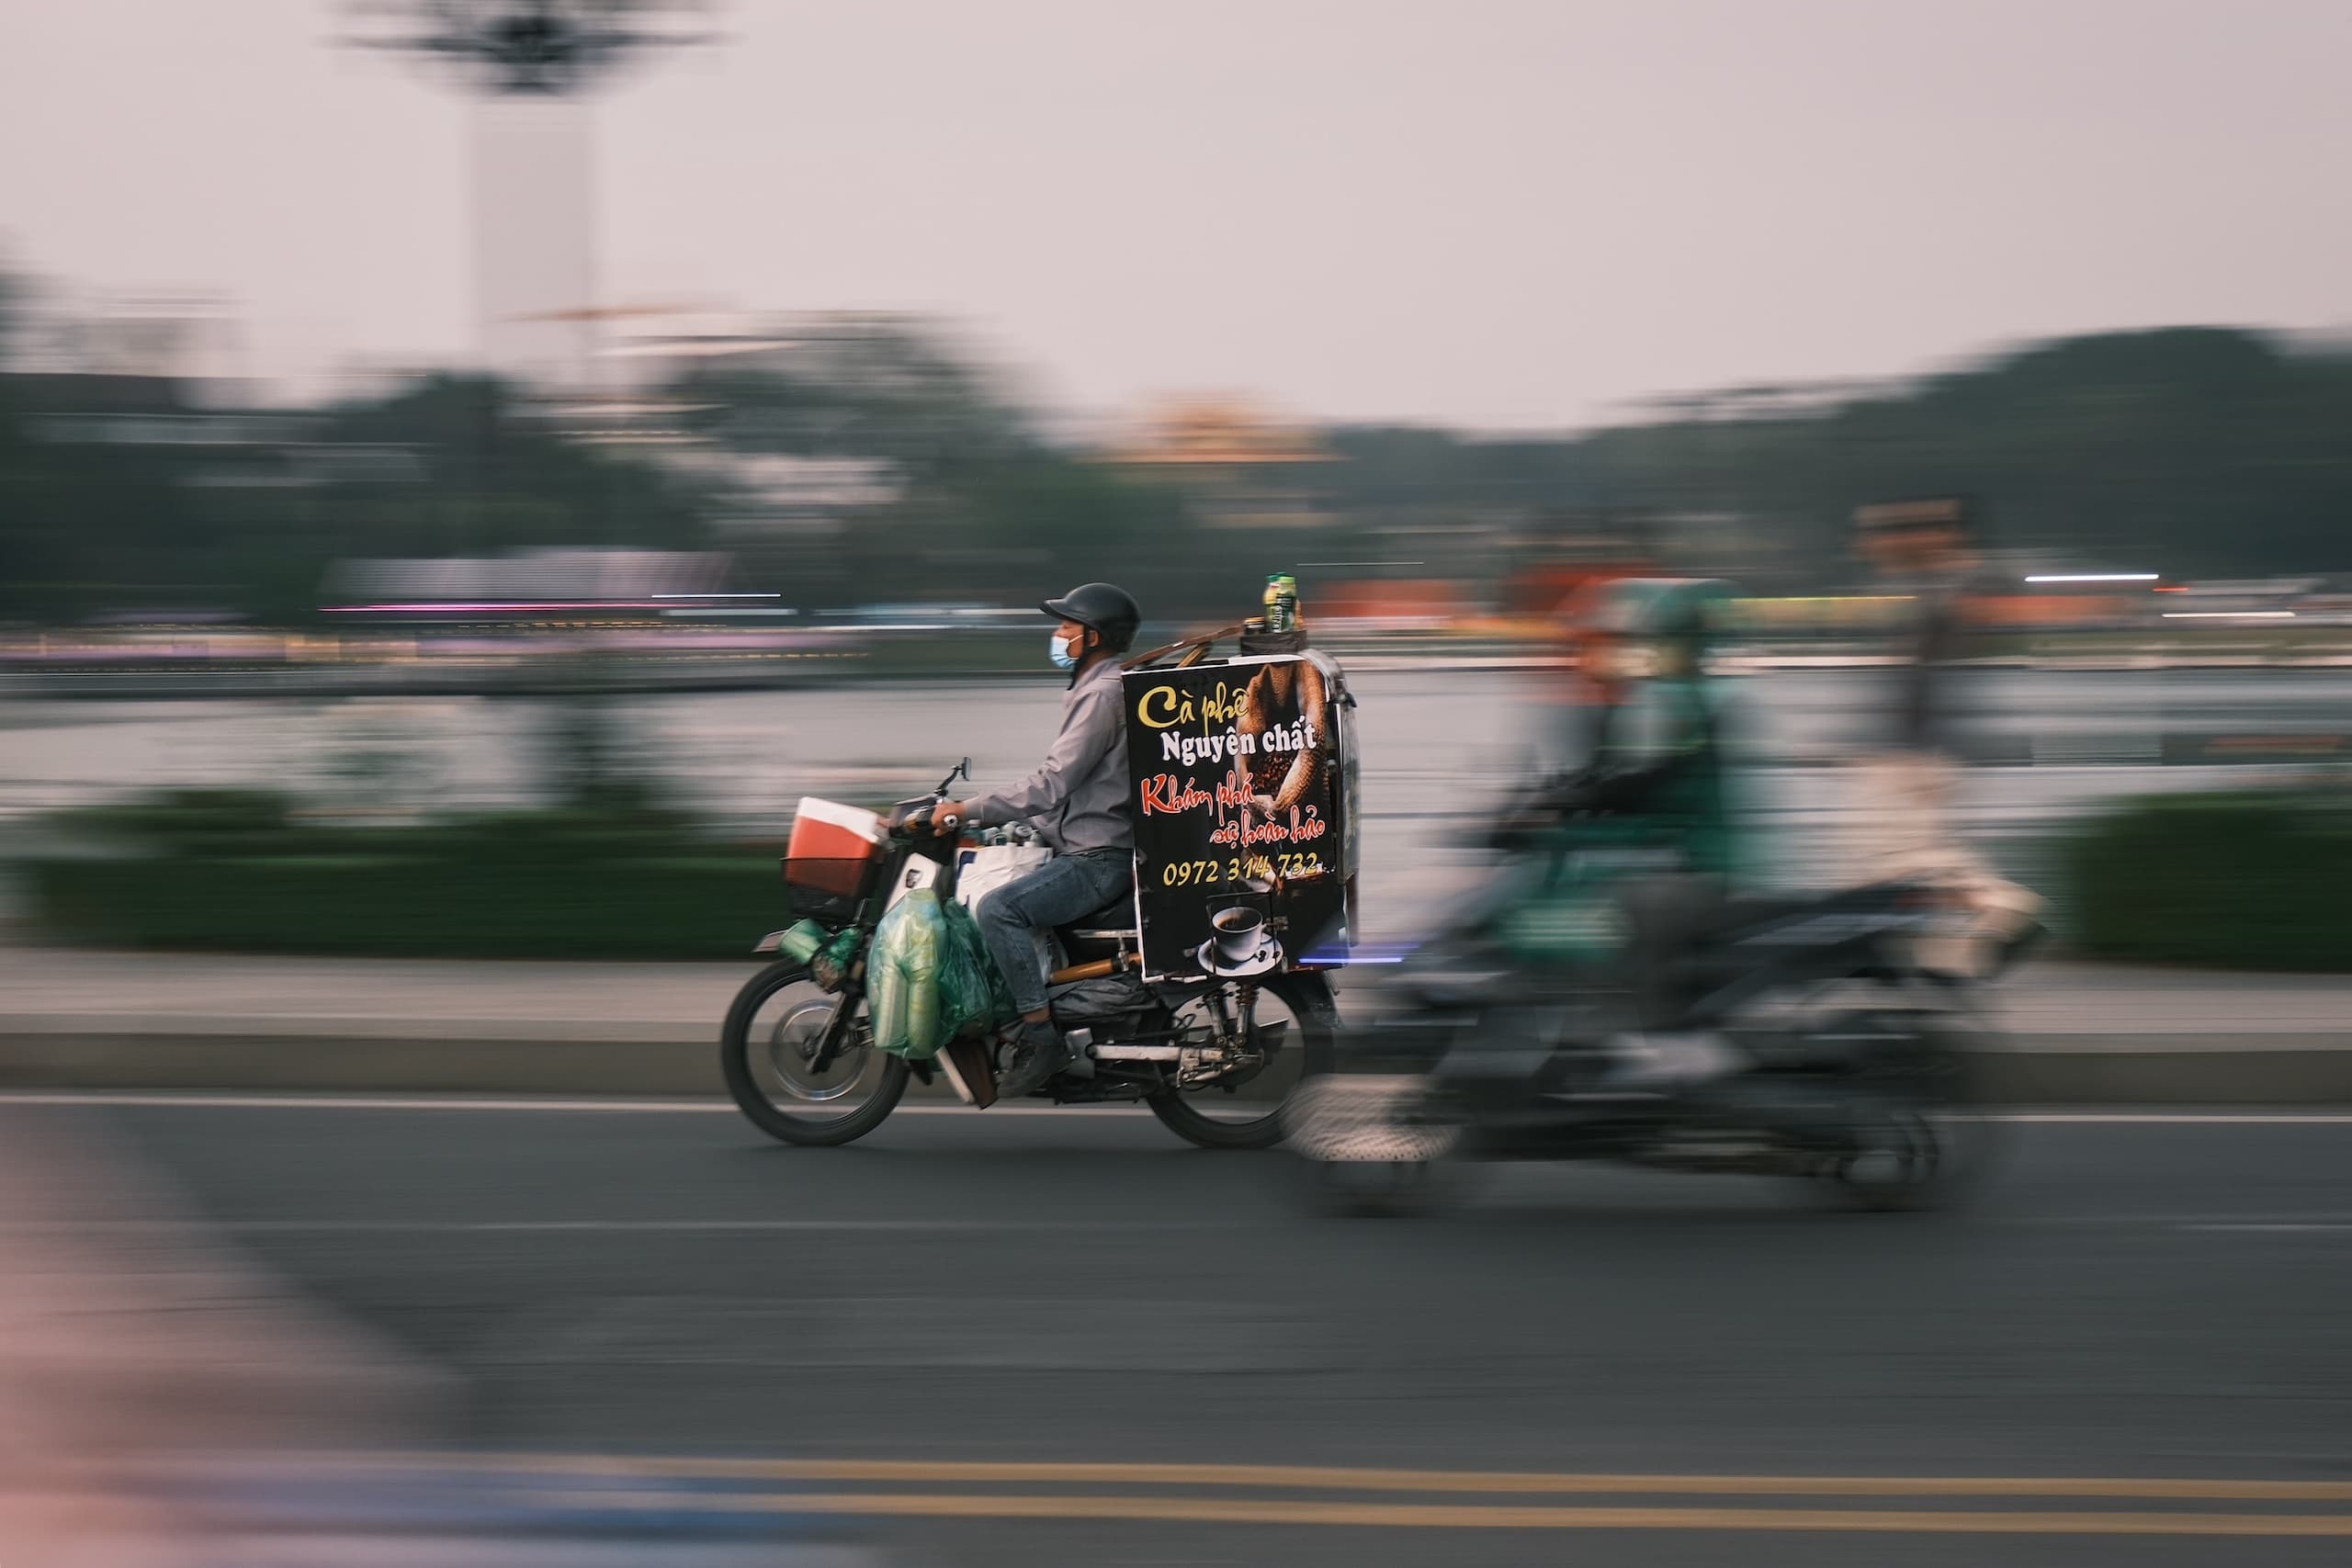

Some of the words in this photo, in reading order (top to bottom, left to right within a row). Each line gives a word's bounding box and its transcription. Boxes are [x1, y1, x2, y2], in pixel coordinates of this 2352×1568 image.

[1138, 686, 1195, 728] Cà
[1201, 682, 1250, 738] phê
[1160, 726, 1257, 767] Nguyên
[1262, 715, 1317, 753] chất
[1140, 773, 1214, 817] Khám
[1216, 770, 1256, 828] phá
[1209, 819, 1239, 849] sự
[1240, 808, 1289, 846] hoàn
[1289, 805, 1326, 844] hảo
[1162, 859, 1220, 886] 0972
[1227, 853, 1272, 883] 314
[1277, 852, 1319, 877] 732
